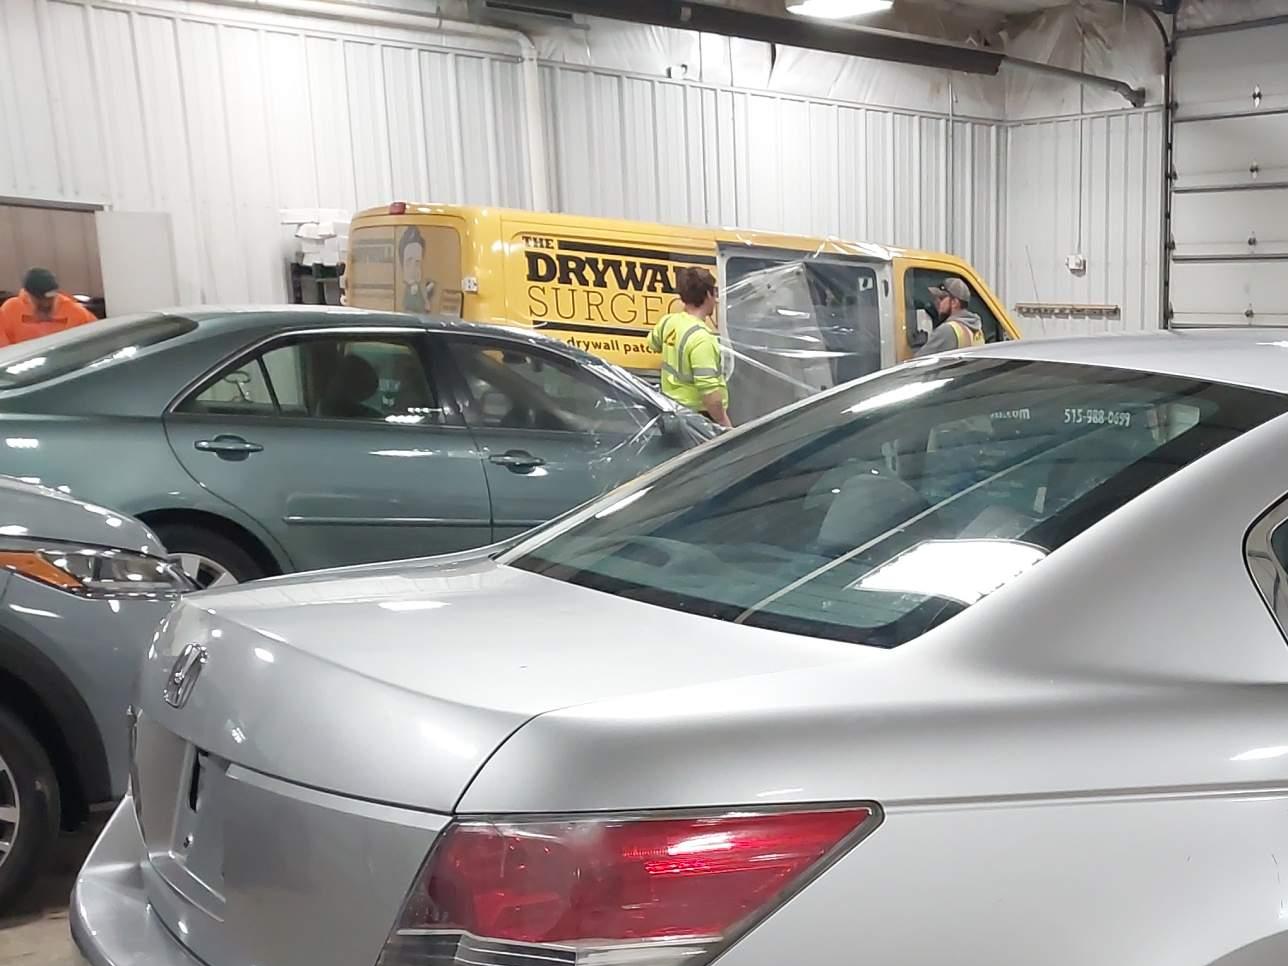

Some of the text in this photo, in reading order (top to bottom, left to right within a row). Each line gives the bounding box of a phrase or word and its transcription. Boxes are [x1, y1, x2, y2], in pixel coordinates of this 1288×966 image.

[522, 236, 554, 249] THE
[567, 336, 662, 355] drywall patc
